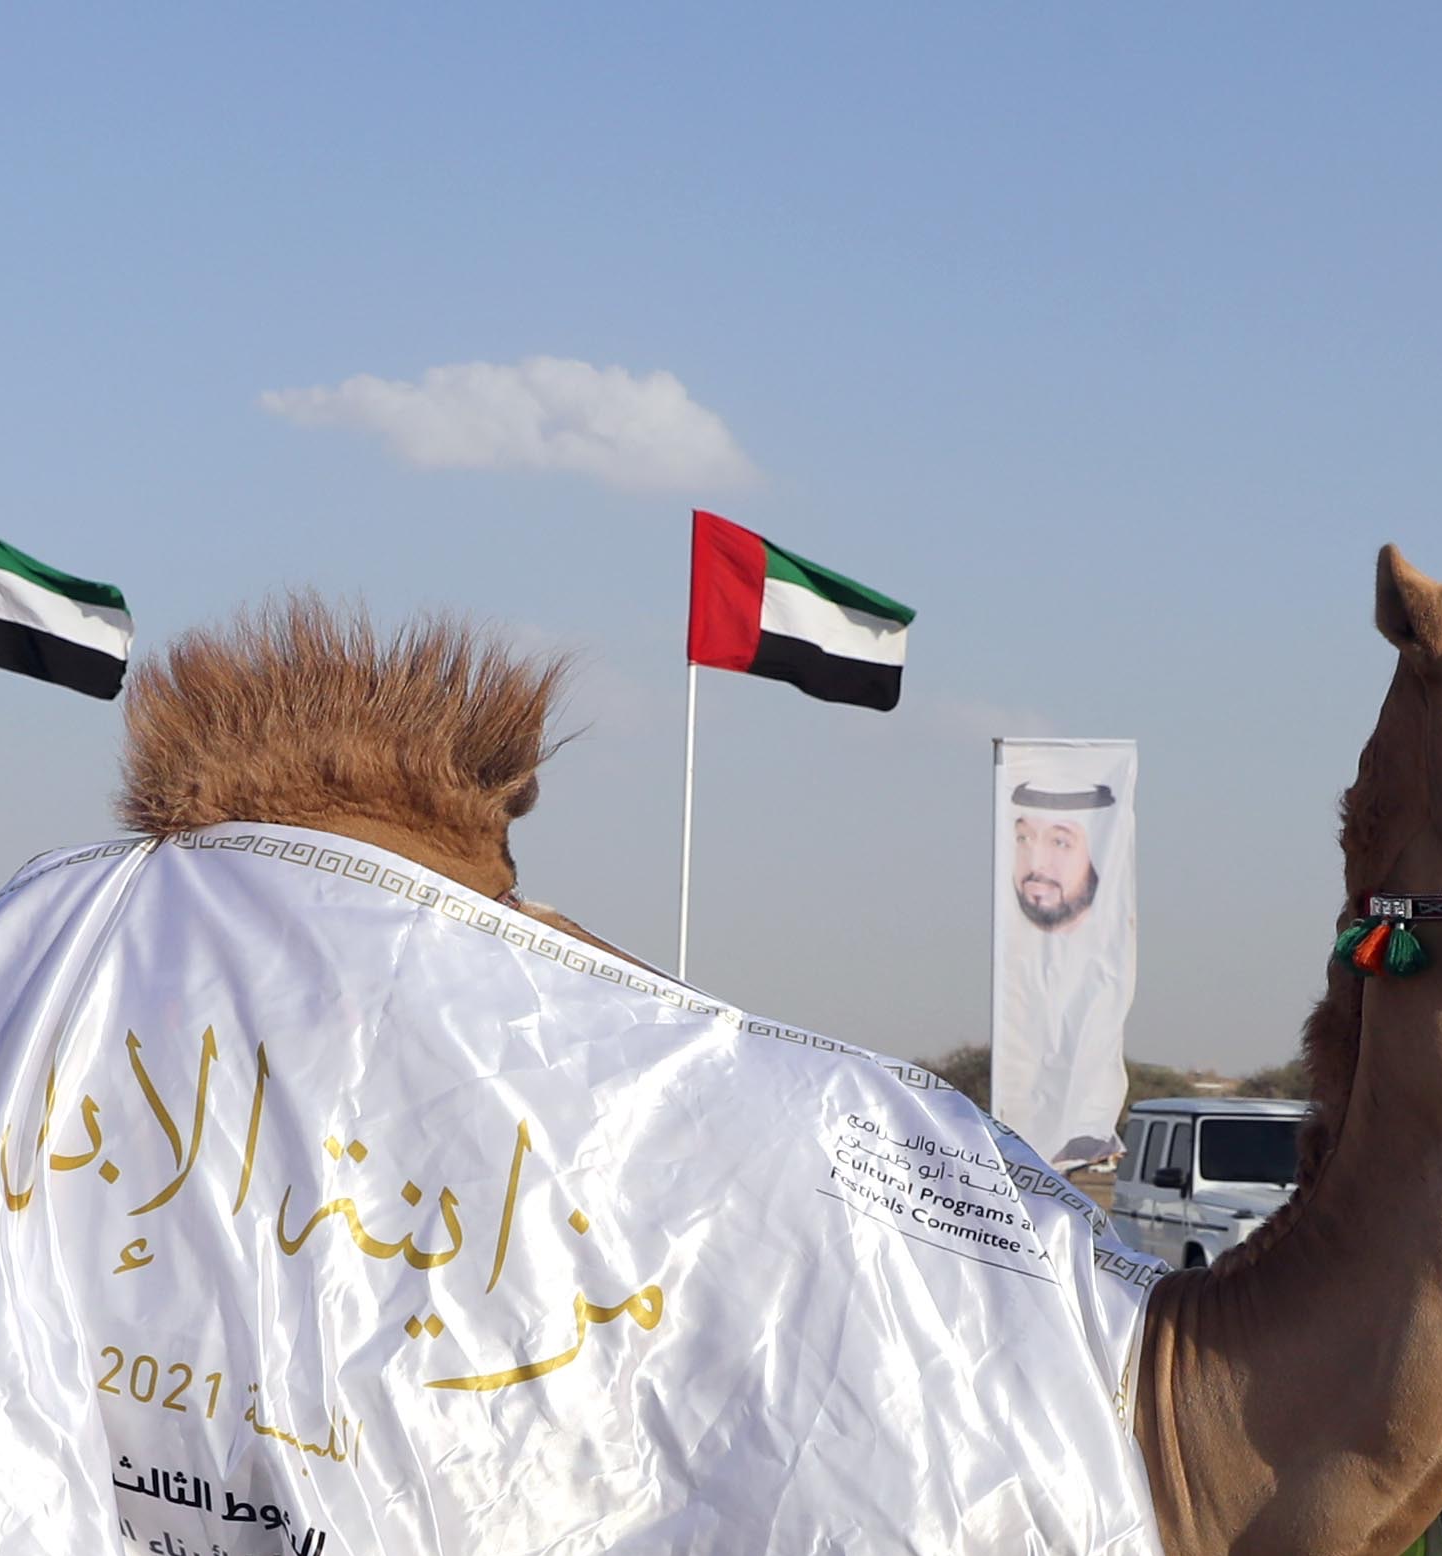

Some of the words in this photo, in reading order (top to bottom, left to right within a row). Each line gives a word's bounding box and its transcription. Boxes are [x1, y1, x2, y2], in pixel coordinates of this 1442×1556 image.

[0, 1024, 270, 1275] الإبل
[835, 1149, 914, 1195] Cultural
[920, 1187, 1014, 1225] Programs
[830, 1166, 905, 1214] Festivals
[911, 1207, 1021, 1252] Committee
[277, 1118, 663, 1392] مزاينة
[97, 1345, 223, 1419] 2021
[112, 1455, 212, 1512] الثالث
